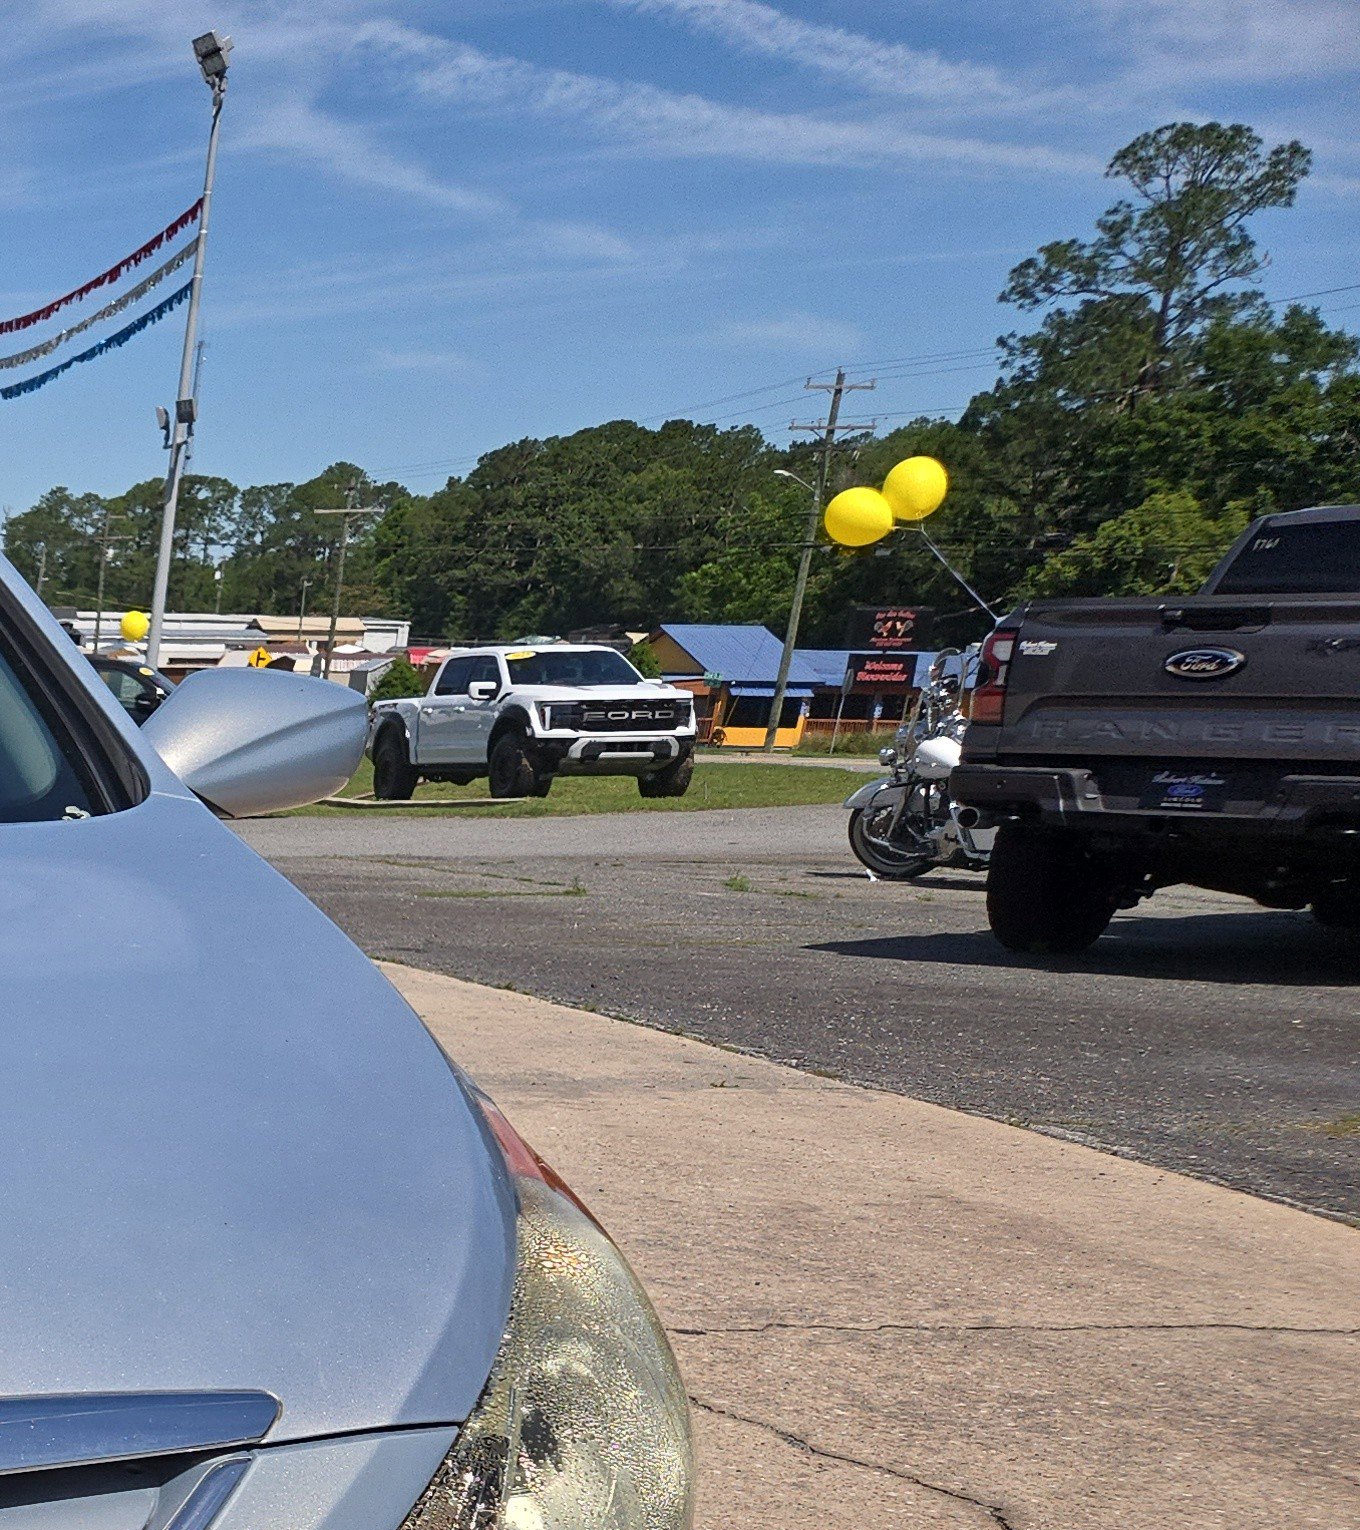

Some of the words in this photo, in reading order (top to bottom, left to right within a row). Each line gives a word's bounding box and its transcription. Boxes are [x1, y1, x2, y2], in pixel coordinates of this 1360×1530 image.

[1180, 655, 1223, 672] Ford
[582, 710, 675, 721] FORD
[1031, 719, 1360, 744] RANGER
